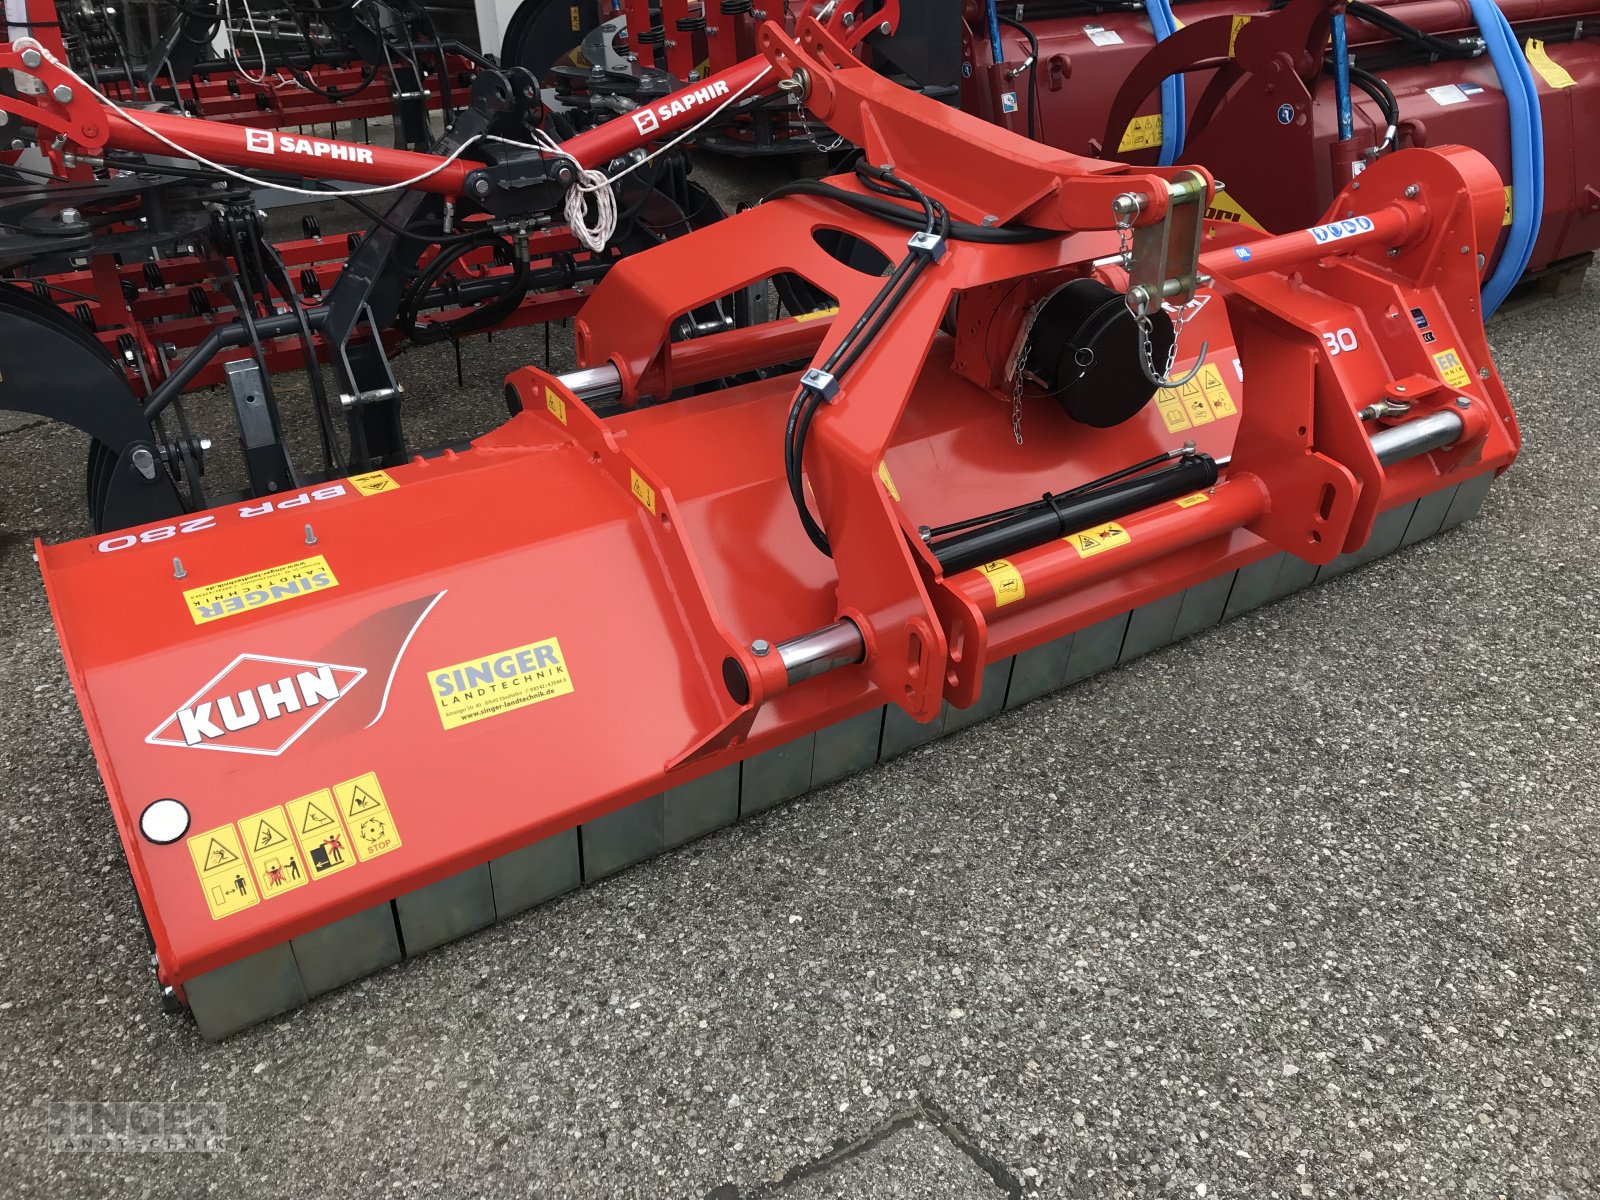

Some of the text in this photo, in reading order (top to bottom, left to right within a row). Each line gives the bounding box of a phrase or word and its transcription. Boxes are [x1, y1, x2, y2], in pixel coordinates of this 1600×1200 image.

[657, 80, 730, 121] SAPHIR
[280, 136, 373, 164] SAPHIR
[97, 484, 347, 553] BPR 280
[193, 567, 325, 606] LANDTECHNIK
[196, 573, 331, 619] SINGER
[435, 644, 560, 697] SINGER
[441, 665, 564, 707] LANDTECHNIK
[176, 665, 340, 746] KUHN
[460, 688, 555, 721] www.singer-landtechnik.de
[367, 838, 392, 854] STOP
